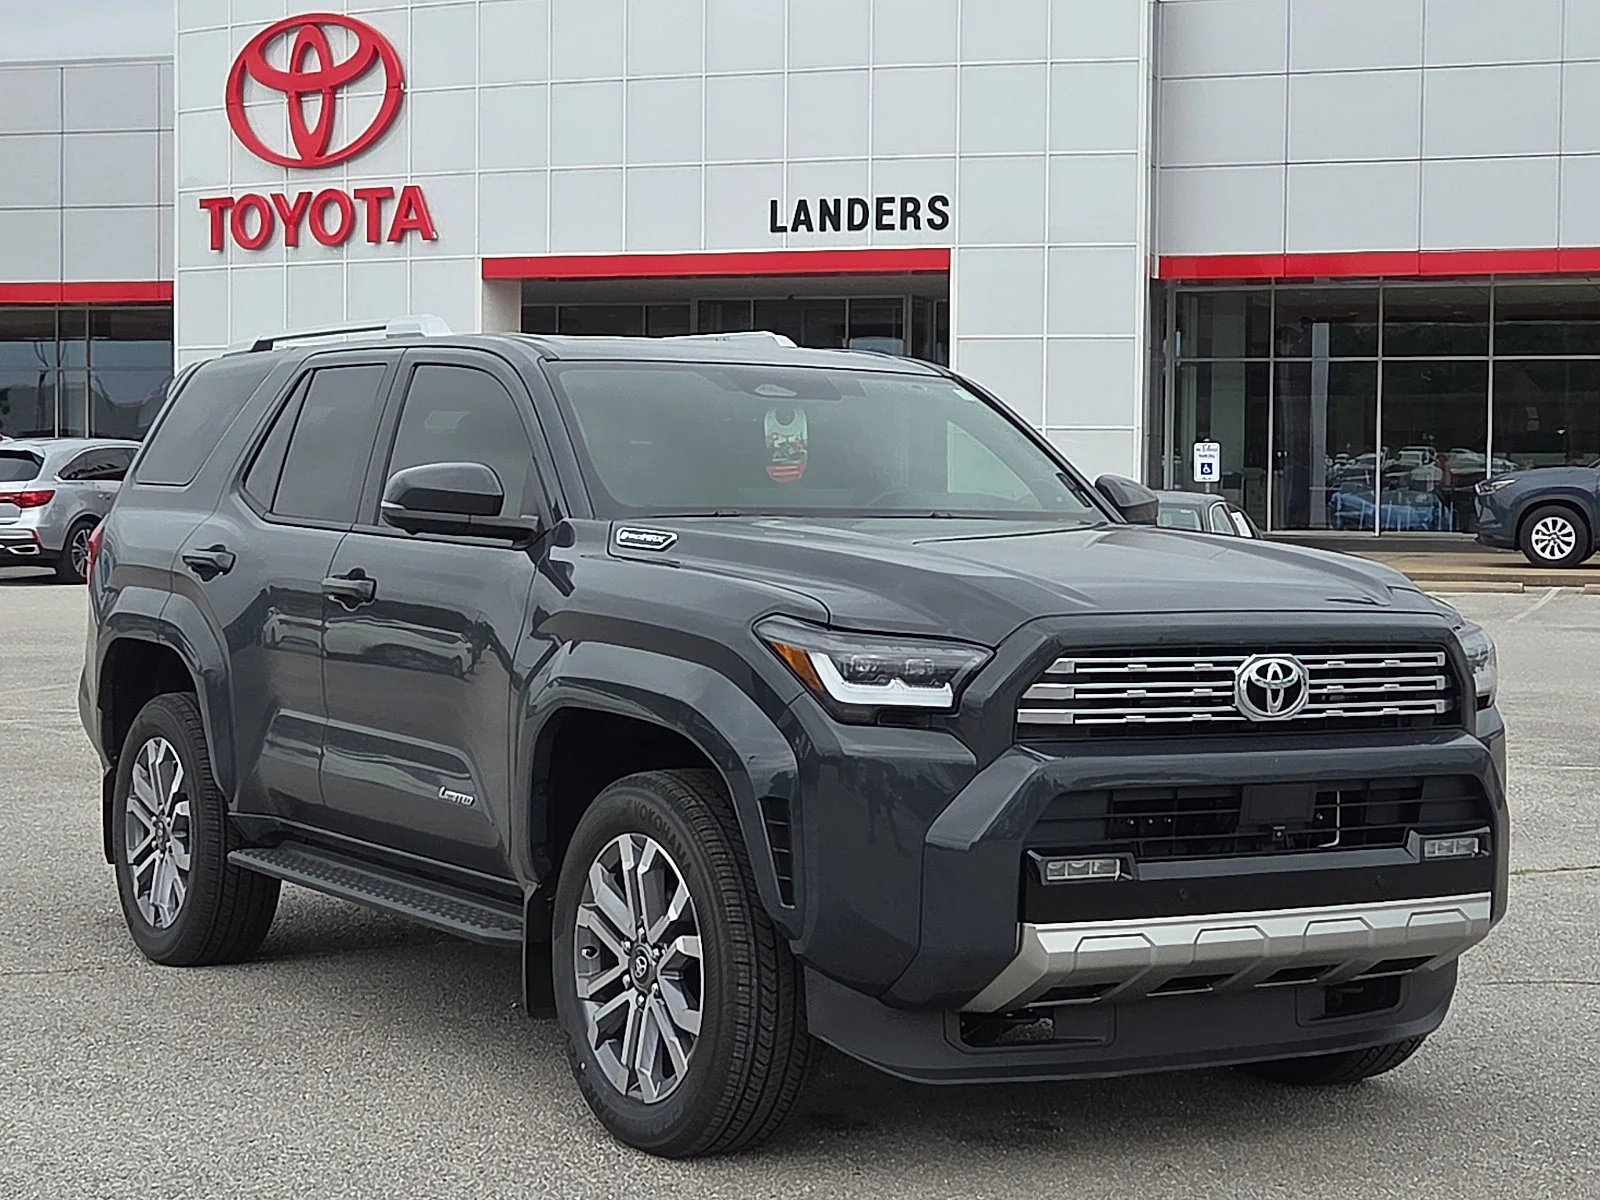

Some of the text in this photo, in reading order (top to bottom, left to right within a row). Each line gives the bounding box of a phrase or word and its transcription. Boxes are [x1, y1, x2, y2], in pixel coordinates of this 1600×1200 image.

[199, 185, 437, 251] TOYOTA
[770, 195, 950, 232] LANDERS
[633, 801, 692, 880] YOKOHAMA
